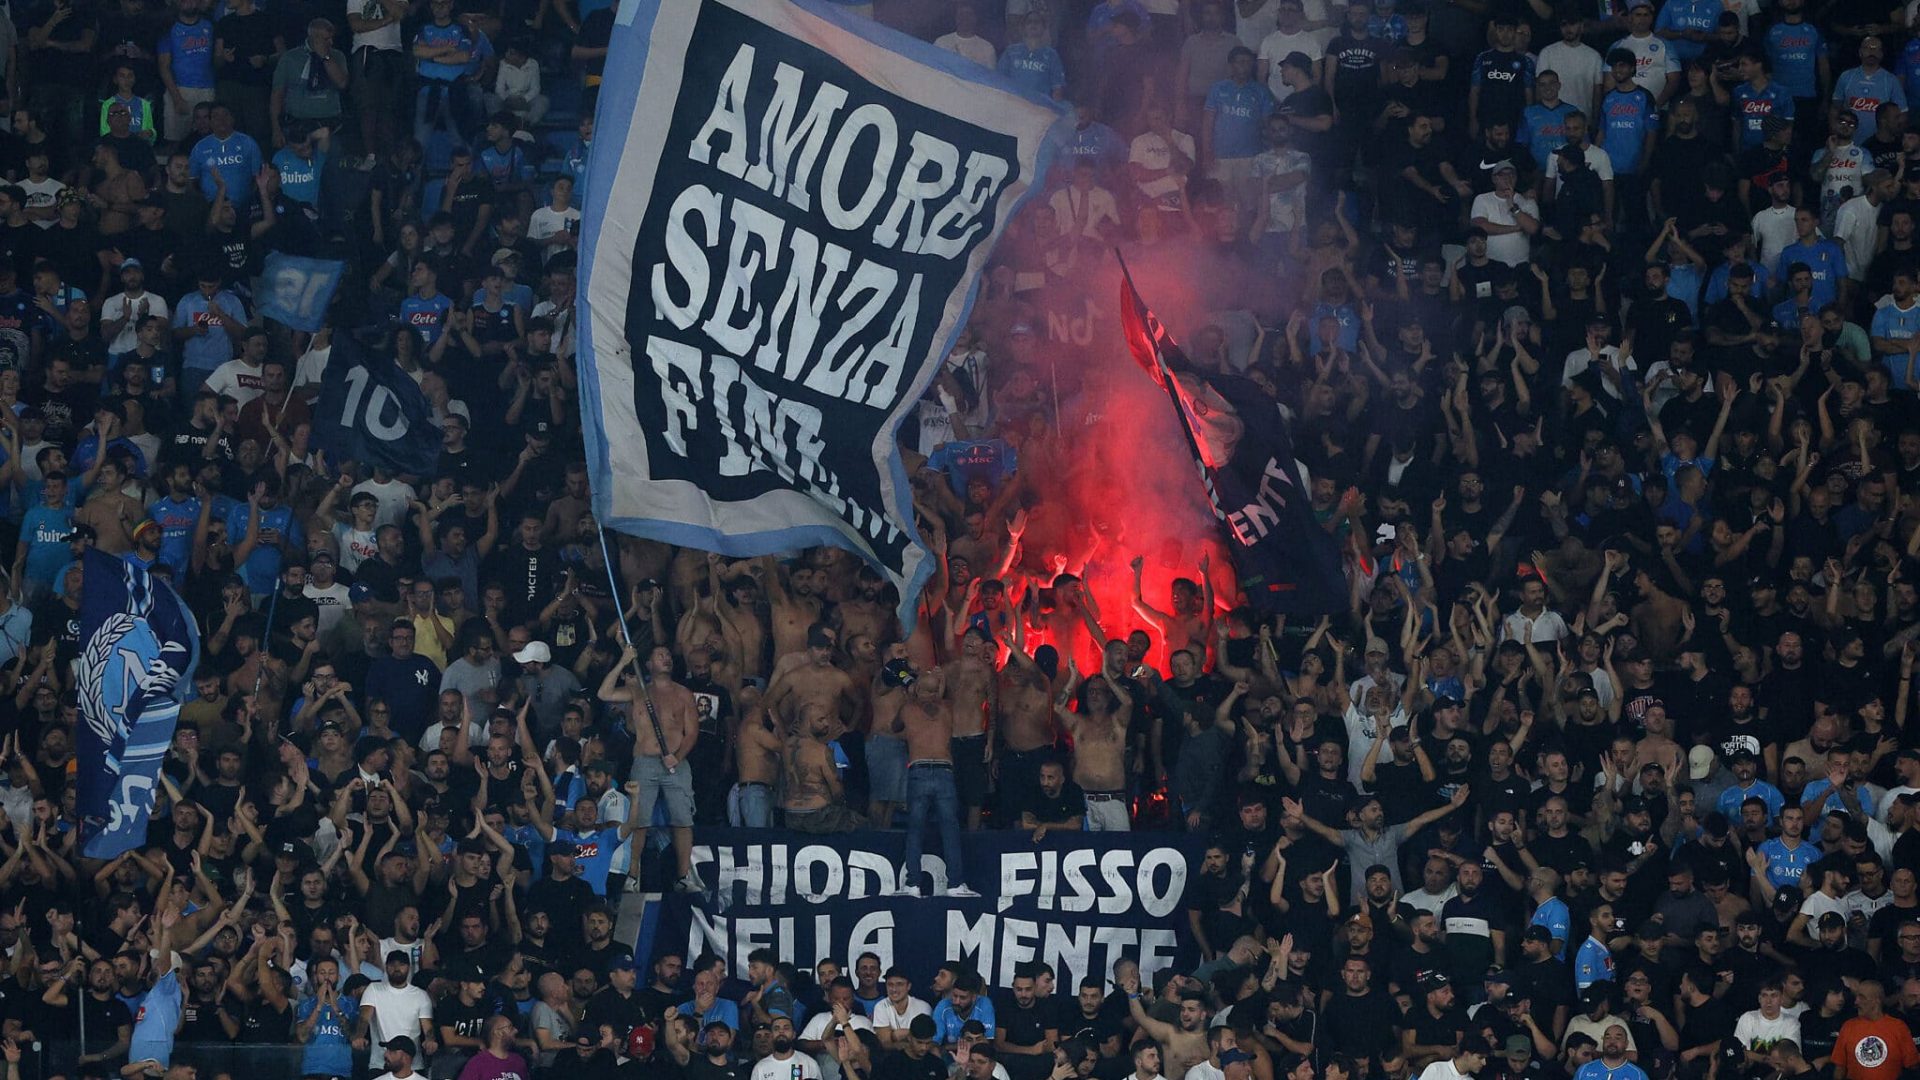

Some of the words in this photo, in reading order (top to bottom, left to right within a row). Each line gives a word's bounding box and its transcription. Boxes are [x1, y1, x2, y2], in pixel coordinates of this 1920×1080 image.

[1686, 16, 1711, 28] MSC
[1023, 60, 1046, 73] MSC
[1634, 57, 1653, 66] ete
[1487, 69, 1516, 83] ebay
[1230, 105, 1252, 118] MSC
[1745, 101, 1771, 113] Lete
[1616, 120, 1635, 129] MSC
[688, 43, 1008, 260] AMORE
[1072, 145, 1098, 155] MSC
[217, 155, 244, 166] MSC
[1830, 157, 1856, 169] Lete
[651, 183, 923, 411] SENZA
[411, 313, 437, 326] Lete
[340, 364, 411, 441] 10
[967, 455, 994, 465] MSC
[415, 669, 430, 686] NY
[1785, 867, 1803, 878] MS
[998, 847, 1187, 917] FISSO
[686, 904, 896, 990] NELLA
[946, 909, 1178, 997] MENTE
